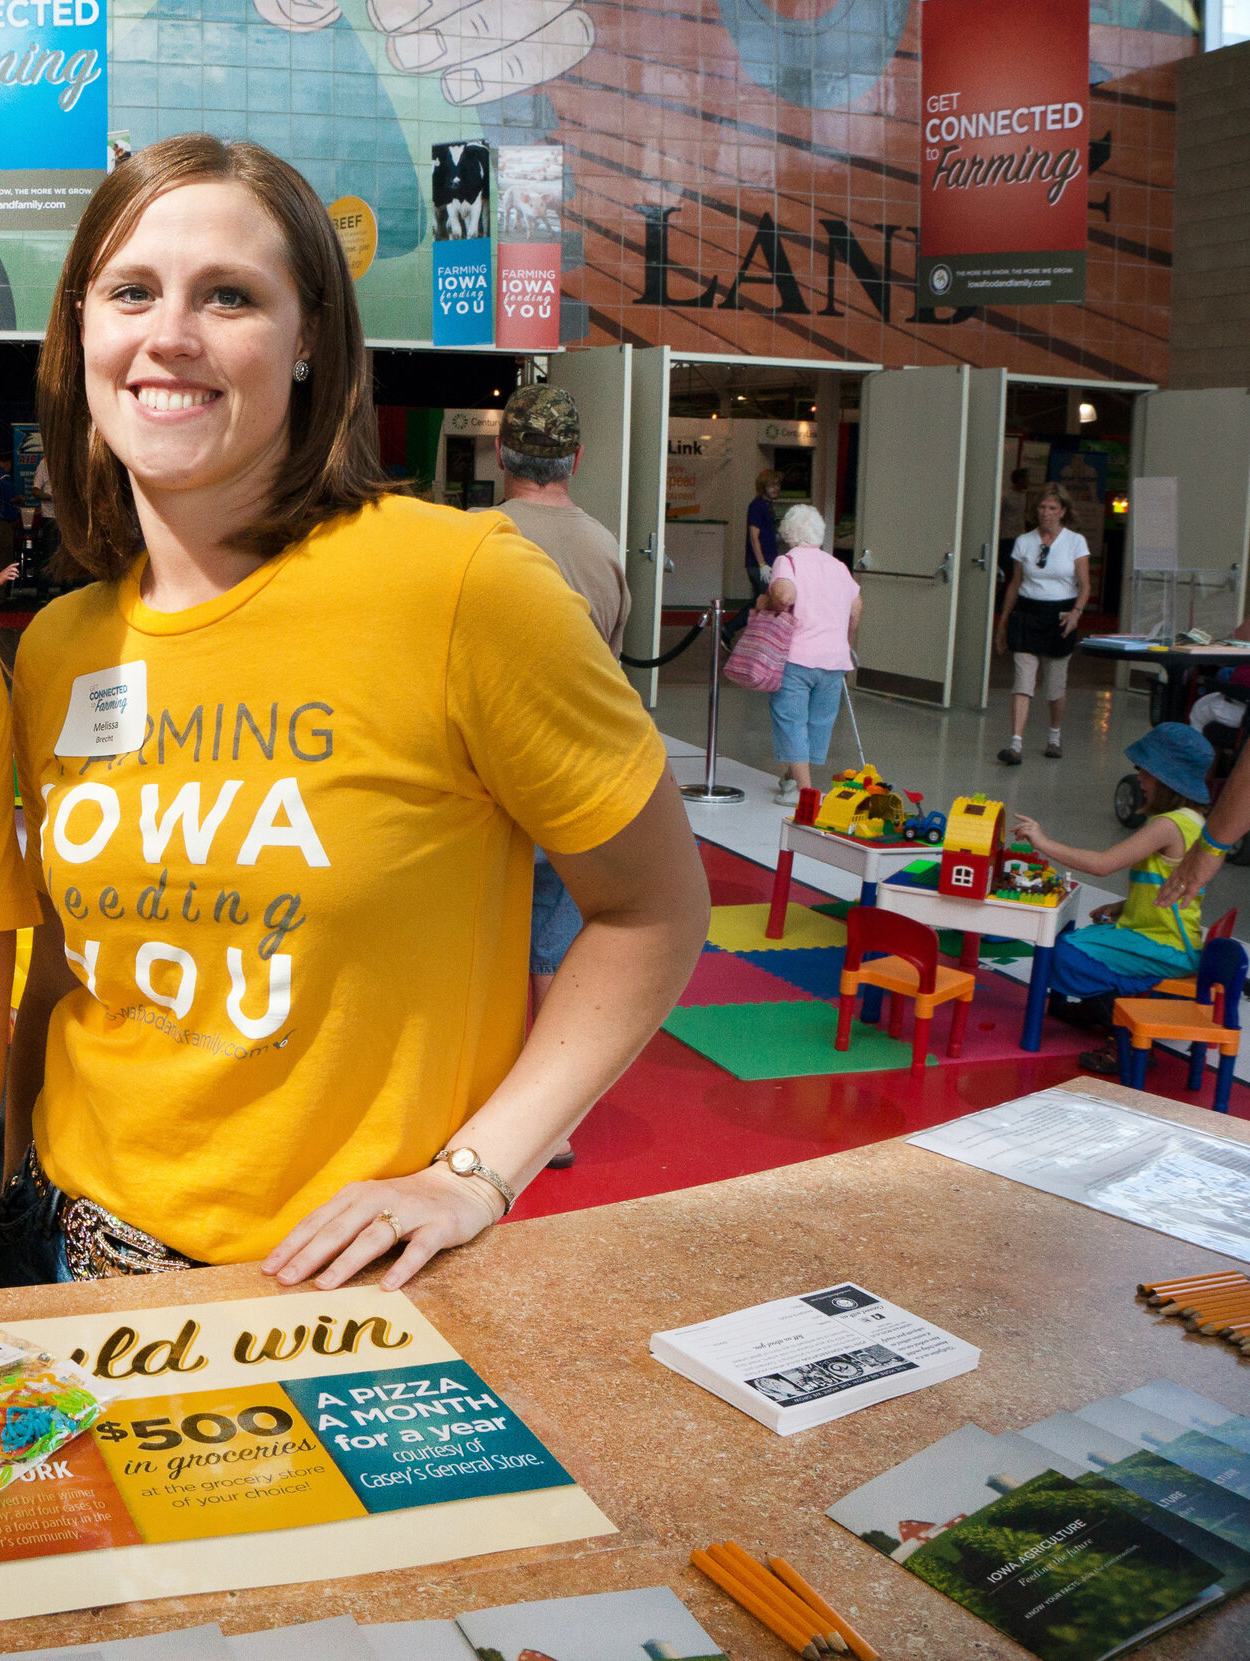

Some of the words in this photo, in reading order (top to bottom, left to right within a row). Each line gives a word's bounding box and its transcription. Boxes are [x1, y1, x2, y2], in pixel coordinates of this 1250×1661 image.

[926, 91, 961, 113] GET
[925, 102, 1083, 143] CONNECTED
[926, 147, 940, 161] to
[932, 144, 1082, 206] Farming
[15, 188, 30, 196] THE
[31, 188, 53, 196] MORE
[54, 188, 68, 196] WE
[437, 264, 487, 276] FARMING
[502, 269, 556, 280] FARMING
[438, 275, 488, 291] IOWA
[502, 280, 555, 294] IOWA
[440, 289, 484, 303] feeding
[503, 292, 552, 307] feeding
[440, 300, 484, 315] YOU
[503, 304, 551, 319] YOU
[89, 684, 128, 700] CONNECTED
[95, 698, 128, 714] Farming
[93, 720, 119, 732] Melissa
[96, 735, 114, 744] Brecht
[50, 868, 307, 961] eeding
[234, 1316, 413, 1365] win
[317, 1392, 347, 1409] A
[349, 1377, 469, 1405] PIZZA
[318, 1413, 349, 1431] A
[350, 1393, 499, 1427] MONTH
[95, 1405, 294, 1451] $500
[334, 1432, 390, 1452] for
[400, 1428, 425, 1443] a
[427, 1415, 508, 1442] year
[124, 1458, 158, 1477] in
[167, 1437, 318, 1481] groceries
[392, 1441, 464, 1463] courtesy
[467, 1437, 486, 1452] of
[141, 1485, 162, 1497] at
[164, 1481, 196, 1496] the
[203, 1472, 274, 1496] grocery
[278, 1463, 326, 1483] store
[360, 1466, 427, 1489] Casey's
[427, 1457, 493, 1479] General
[493, 1451, 545, 1469] Store.
[25, 1494, 37, 1507] by
[38, 1491, 55, 1502] the
[59, 1488, 96, 1502] winner
[171, 1494, 192, 1509] of
[195, 1489, 240, 1508] your
[244, 1480, 311, 1501] choice!
[15, 1506, 36, 1518] and
[38, 1504, 60, 1517] four
[62, 1501, 92, 1514] cases
[93, 1500, 106, 1510] to
[5, 1524, 12, 1533] a
[14, 1519, 40, 1532] food
[42, 1515, 80, 1531] pantry
[81, 1513, 92, 1523] in
[94, 1511, 113, 1522] the
[16, 1529, 83, 1547] community.
[986, 1562, 1019, 1584] IOWA
[1017, 1518, 1087, 1566] AGRICULTURE
[1017, 1564, 1053, 1588] Feeding
[1054, 1554, 1067, 1566] the
[1066, 1537, 1094, 1557] future
[1024, 1602, 1046, 1620] KNOW
[1045, 1591, 1063, 1606] YOUR
